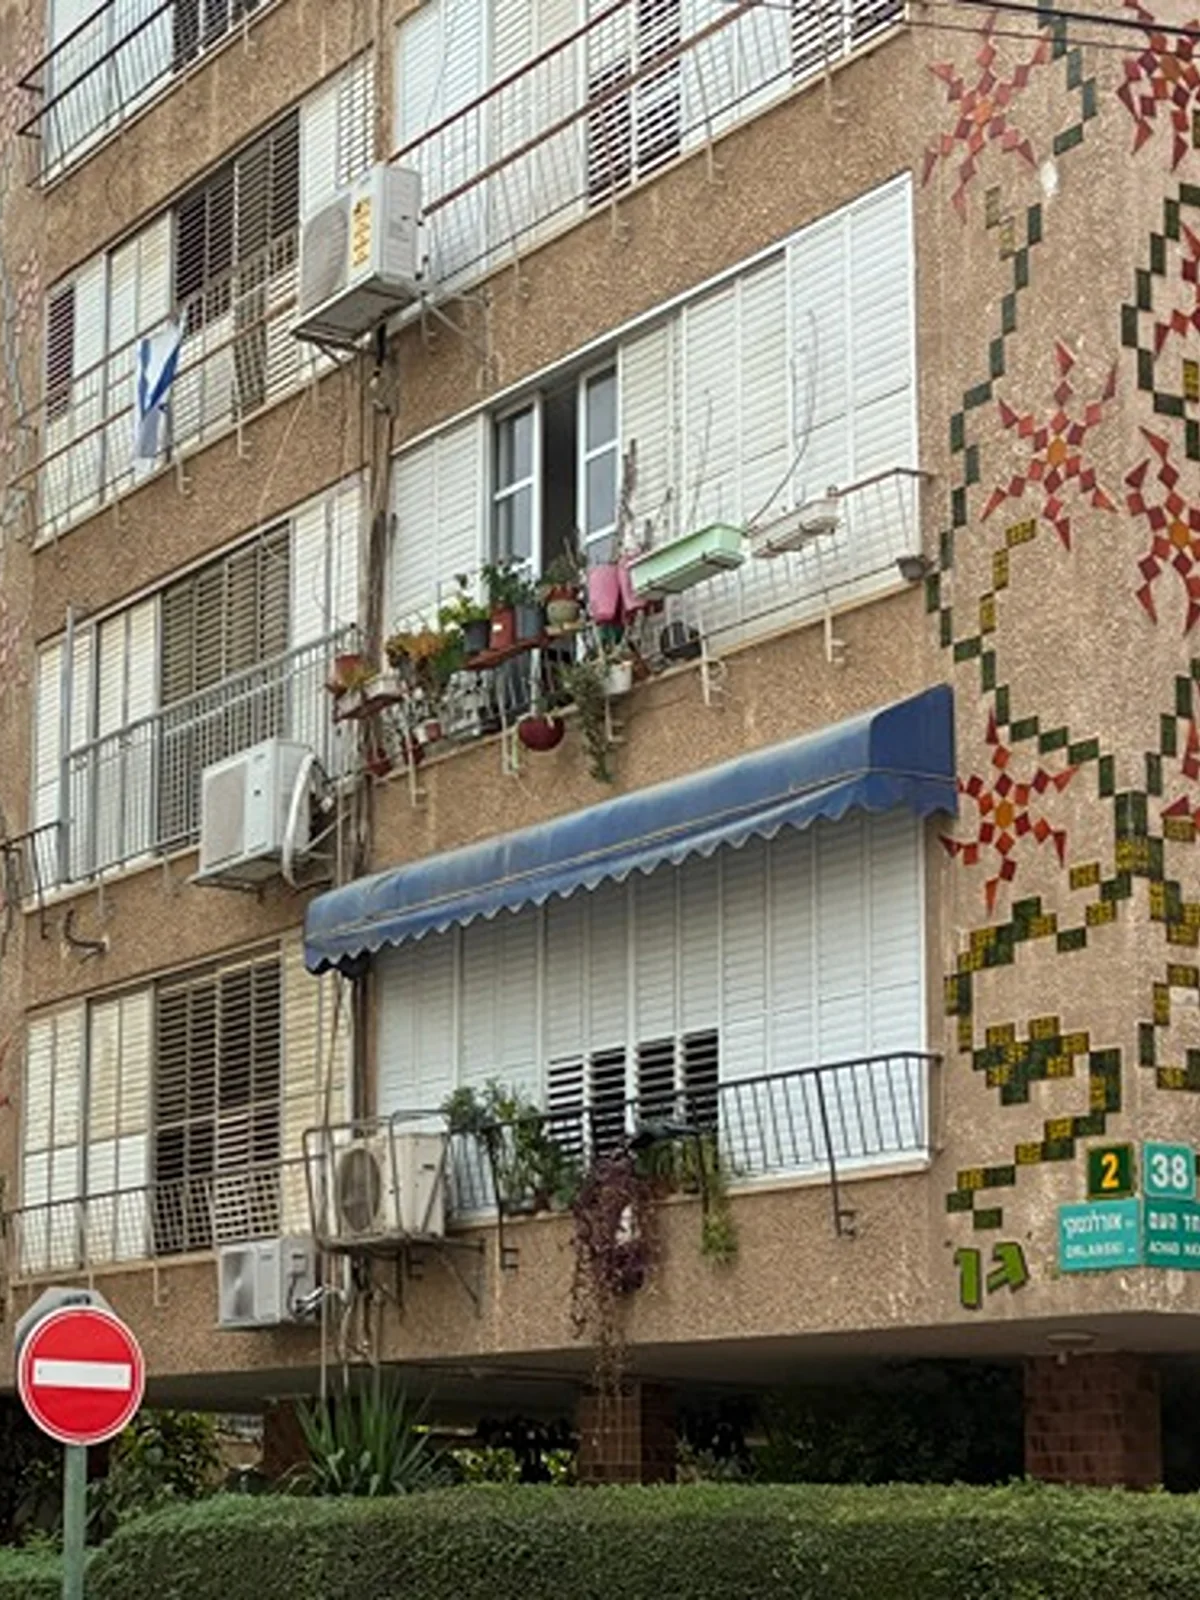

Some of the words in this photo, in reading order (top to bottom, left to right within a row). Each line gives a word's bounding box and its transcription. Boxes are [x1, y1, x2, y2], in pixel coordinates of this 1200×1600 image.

[1101, 1153, 1119, 1189] 2
[1151, 1153, 1189, 1189] 38
[954, 1241, 1029, 1310] גן
